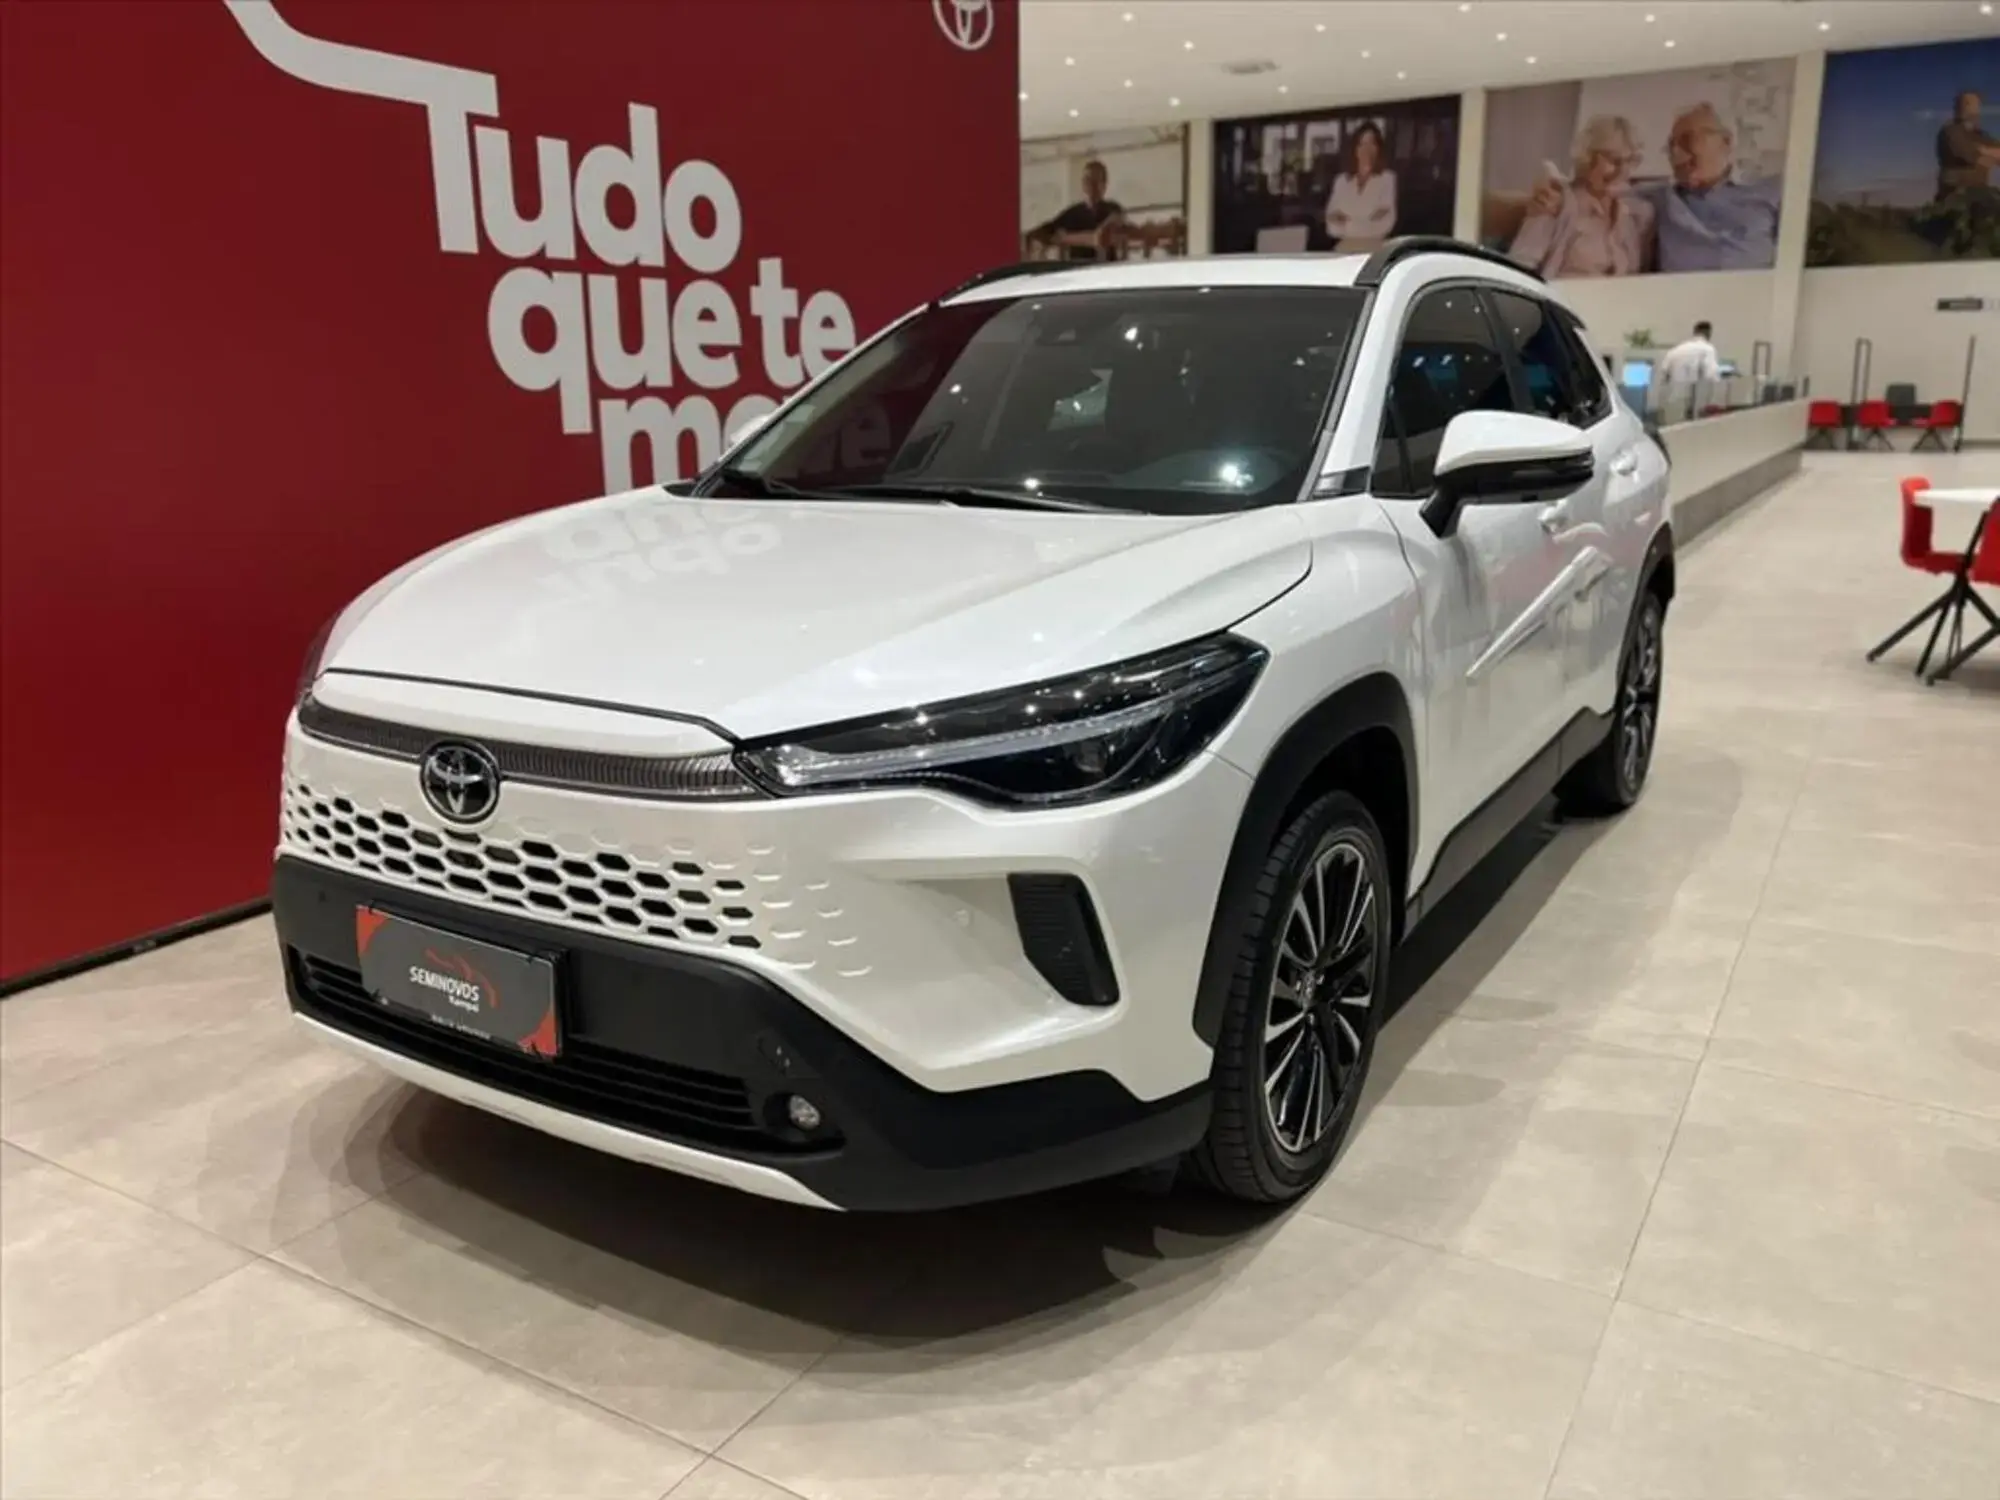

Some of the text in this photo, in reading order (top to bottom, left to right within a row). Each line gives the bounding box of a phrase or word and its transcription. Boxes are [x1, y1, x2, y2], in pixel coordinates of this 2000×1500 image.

[396, 62, 742, 274] Tudo
[488, 256, 856, 435] que te
[409, 966, 480, 1002] SEMINOVOS
